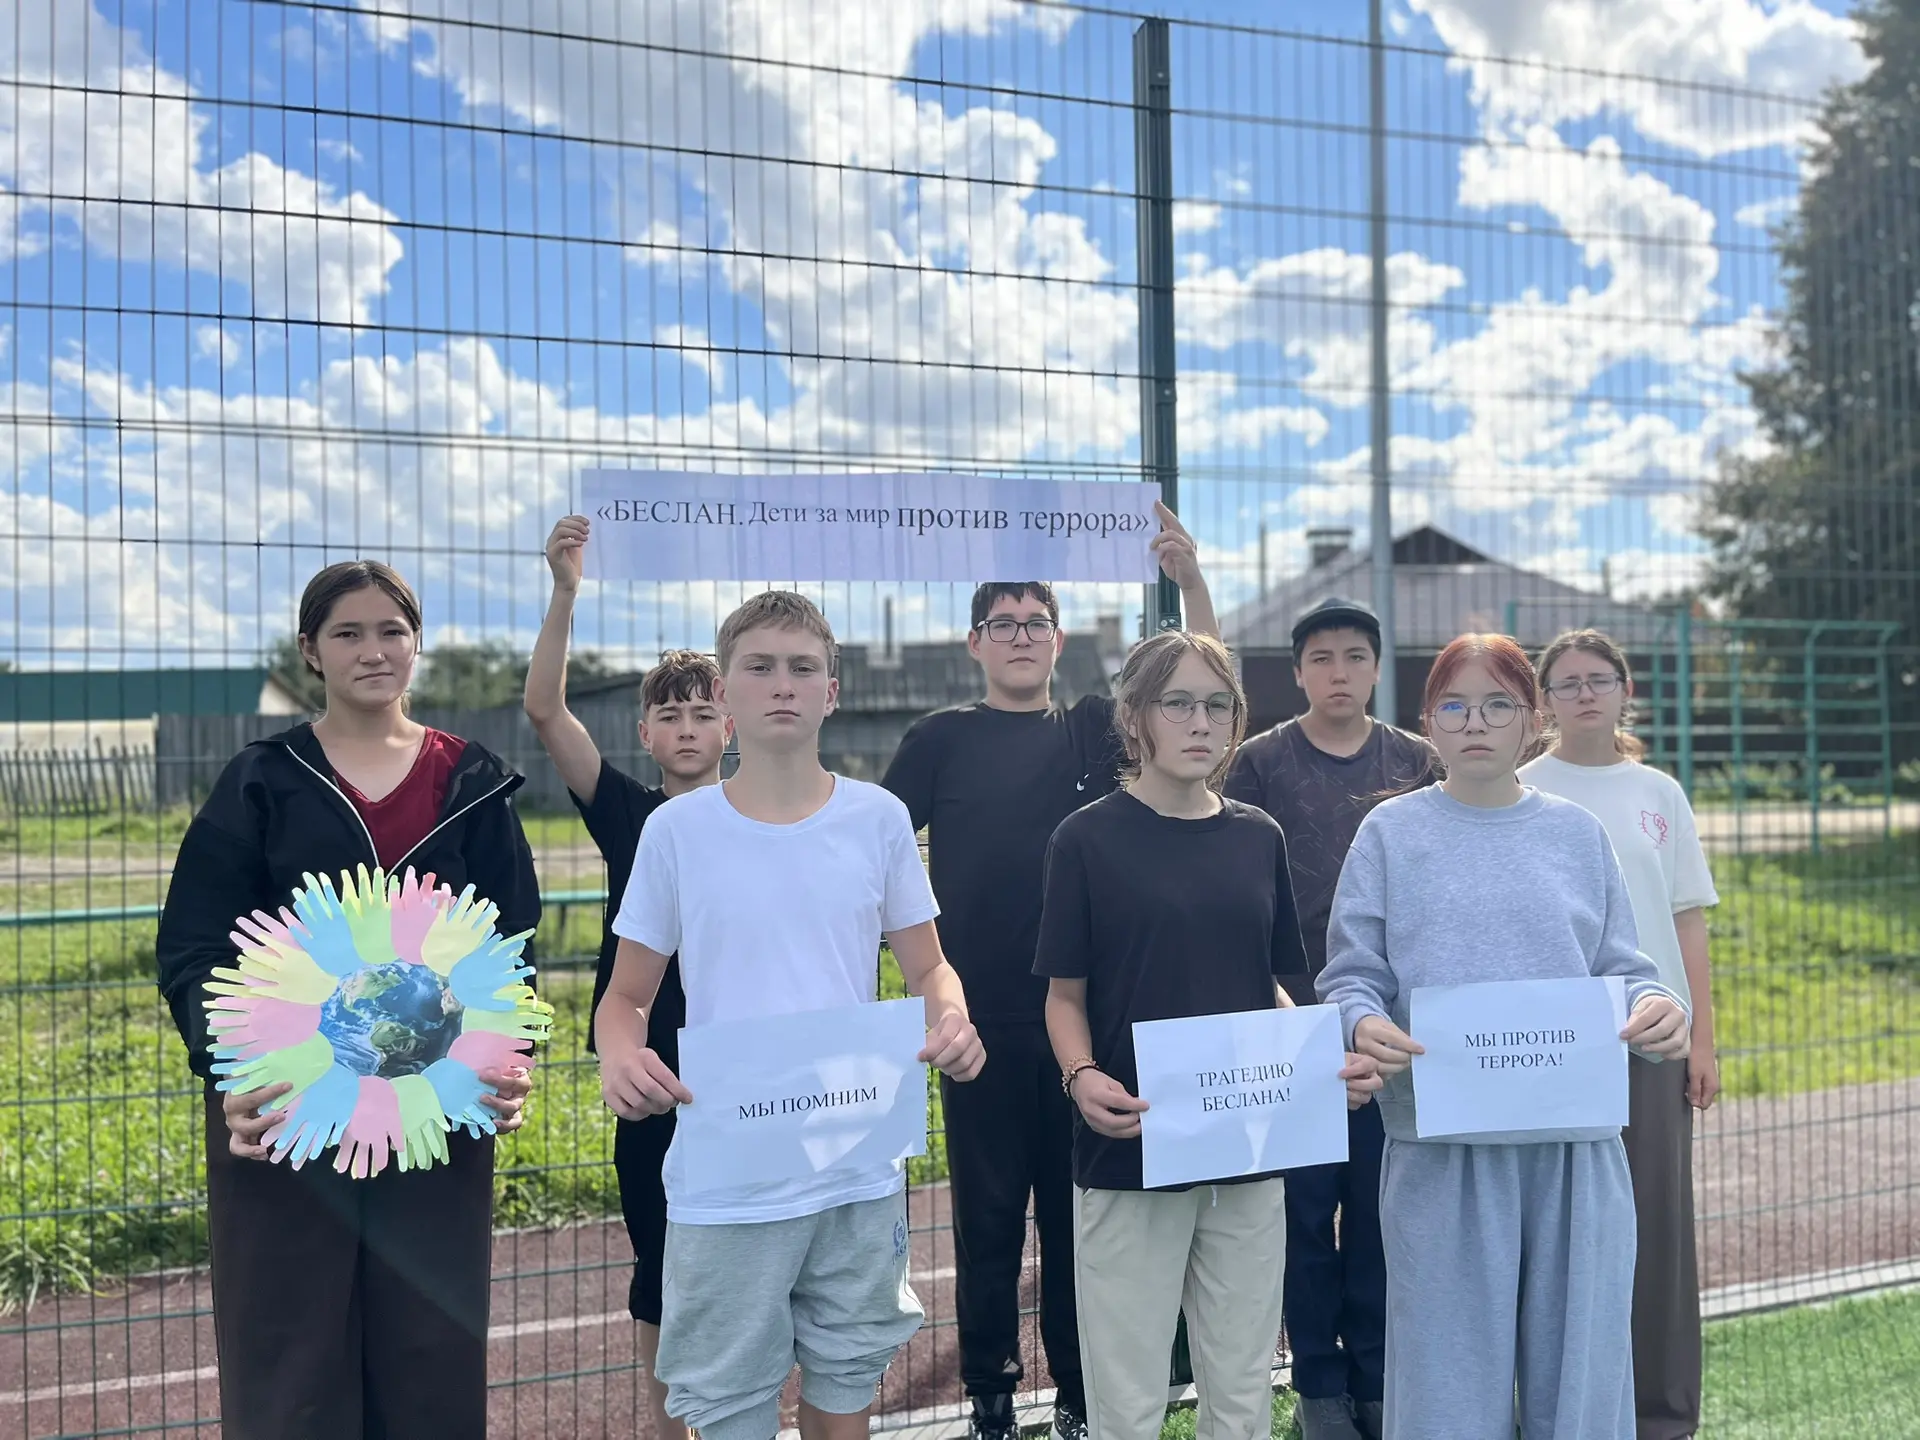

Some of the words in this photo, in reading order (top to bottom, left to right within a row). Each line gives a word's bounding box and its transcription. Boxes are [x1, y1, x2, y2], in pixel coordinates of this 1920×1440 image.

[597, 500, 743, 526] «БЕСЛАН.
[748, 501, 807, 527] Дети
[815, 507, 838, 523] за
[846, 507, 890, 529] мир
[897, 507, 1009, 536] против
[1019, 510, 1149, 538] террора»
[1464, 1032, 1496, 1048] МЫ
[1502, 1029, 1576, 1047] ПРОТИВ
[1477, 1052, 1563, 1069] ТЕРРОРА!
[1196, 1062, 1293, 1088] ТРАГЕДИЮ
[738, 1100, 775, 1120] МЫ
[781, 1086, 878, 1114] ПОМНИМ
[1202, 1087, 1291, 1112] БЕСЛАНА!
